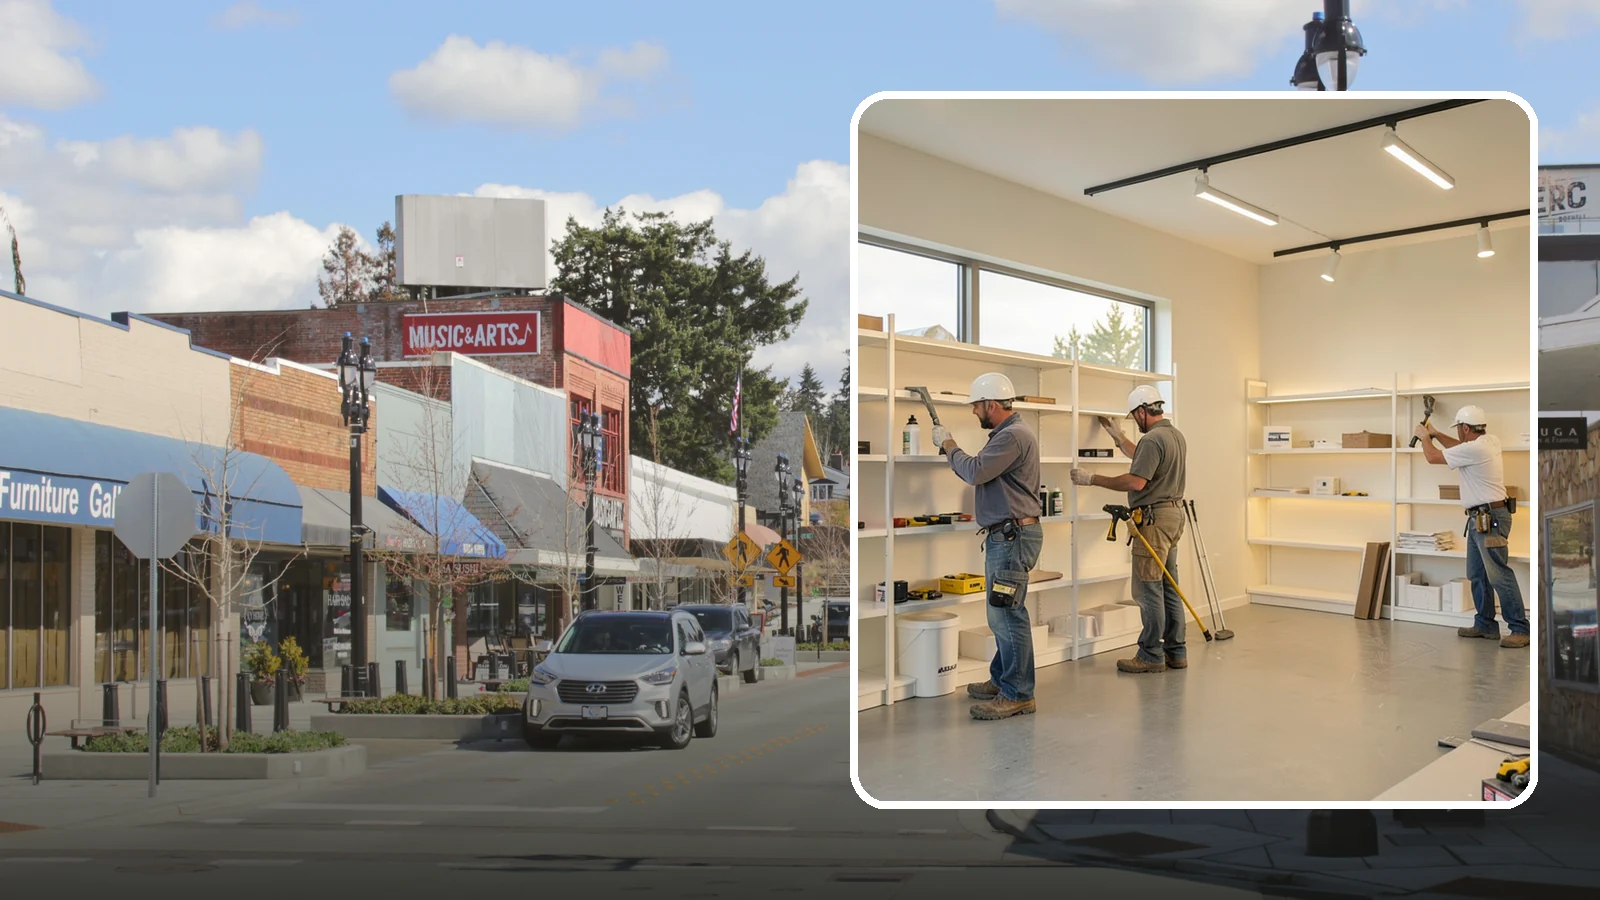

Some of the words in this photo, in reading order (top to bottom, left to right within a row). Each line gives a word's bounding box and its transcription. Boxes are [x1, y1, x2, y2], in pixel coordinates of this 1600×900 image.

[409, 323, 520, 349] MUSIC&ARTS
[0, 471, 79, 515] Furniture
[89, 482, 122, 519] Gal
[453, 563, 479, 574] SUSHI
